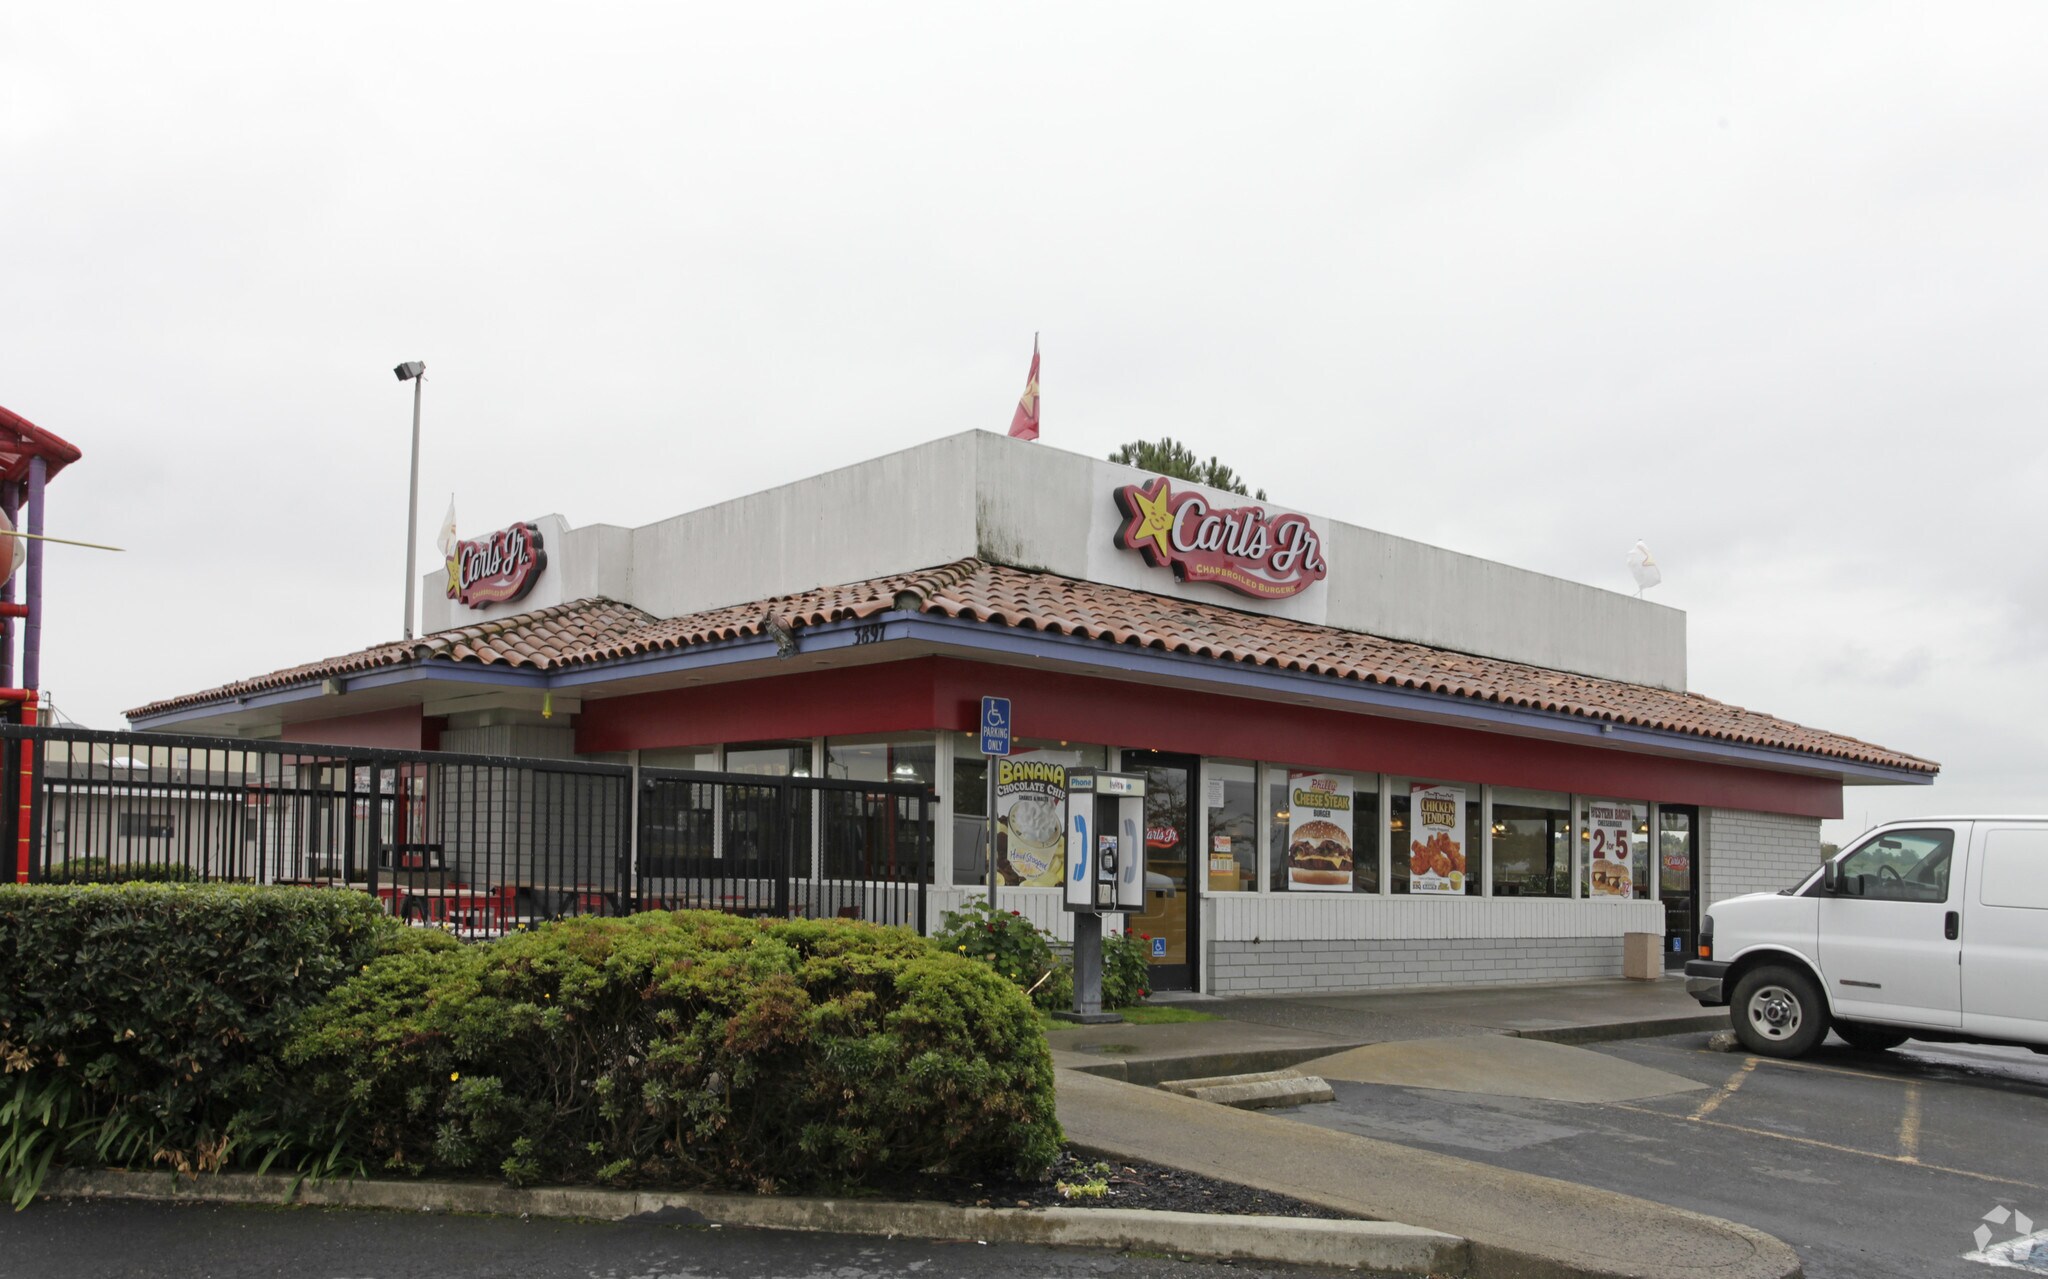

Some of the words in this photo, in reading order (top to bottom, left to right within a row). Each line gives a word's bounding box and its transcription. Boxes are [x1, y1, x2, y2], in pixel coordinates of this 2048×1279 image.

[1171, 499, 1271, 560] Carl's
[1272, 519, 1325, 572] Jr.
[1196, 563, 1257, 590] CHARBROILED
[1257, 582, 1296, 595] BURGERS
[853, 623, 887, 646] 3897
[983, 726, 1008, 739] PARKING
[987, 739, 1003, 751] ONLY
[999, 759, 1066, 789] BANANA
[997, 781, 1045, 796] CHOCOLATE
[1071, 778, 1092, 787] Phone
[1311, 778, 1337, 795] Philly
[1313, 809, 1331, 818] BURGER
[1421, 798, 1456, 814] CHICKEN
[1591, 806, 1613, 820] WESTERN
[1614, 808, 1631, 821] BACON
[1422, 811, 1456, 828] TENDERS
[1593, 828, 1605, 859] 2
[1606, 840, 1615, 850] for
